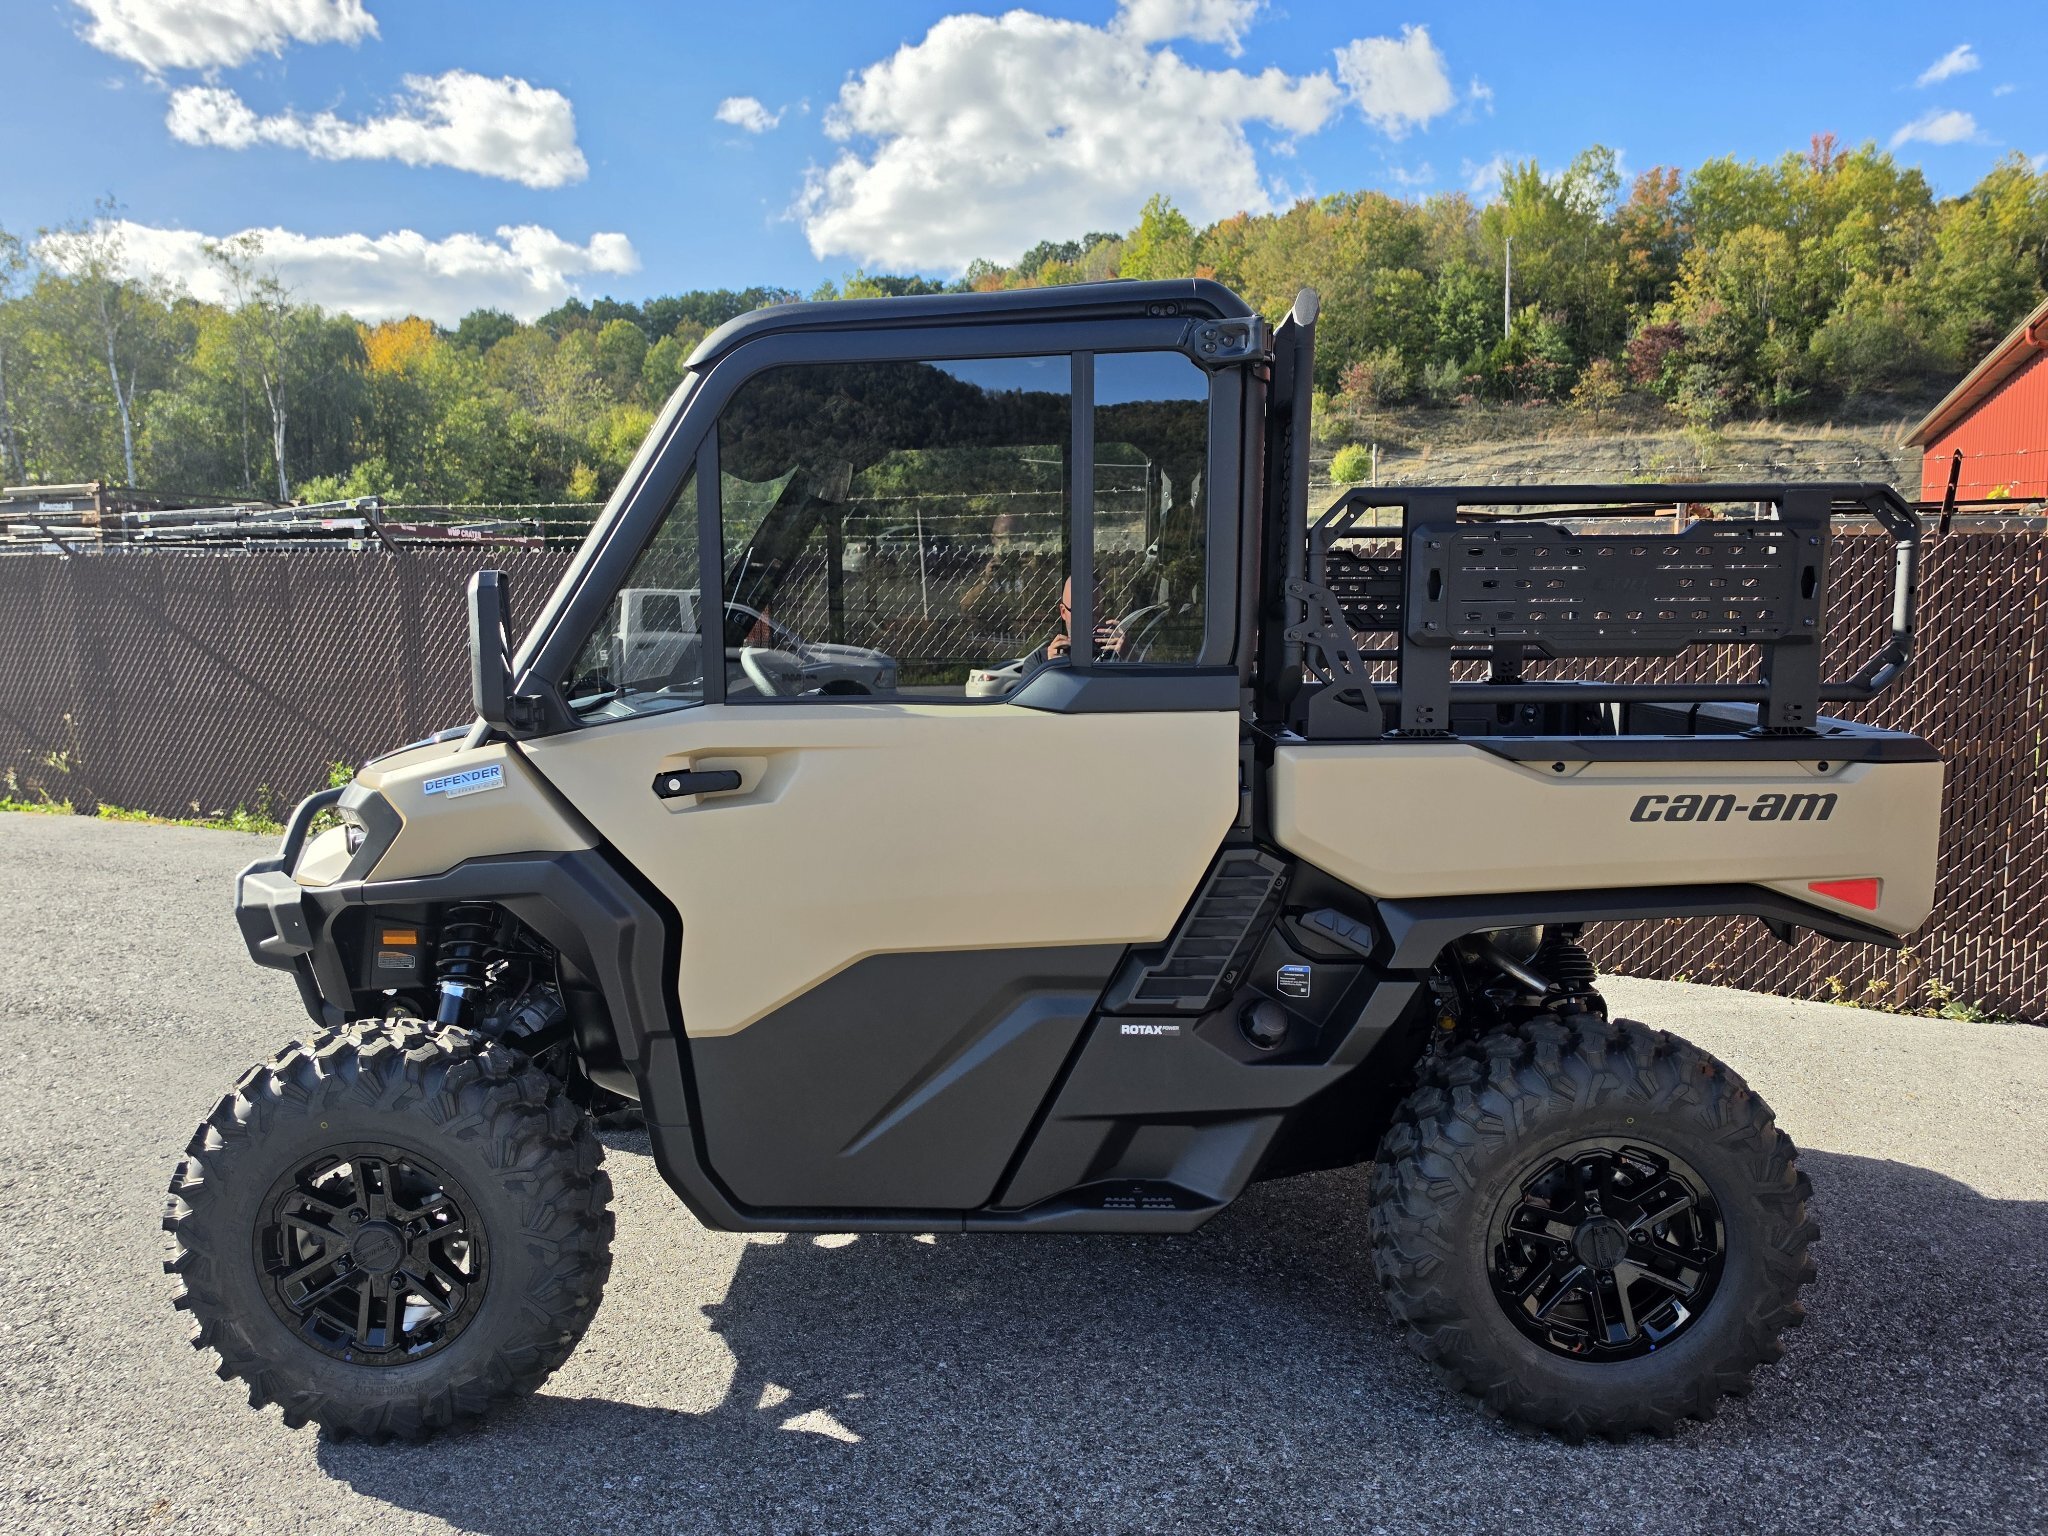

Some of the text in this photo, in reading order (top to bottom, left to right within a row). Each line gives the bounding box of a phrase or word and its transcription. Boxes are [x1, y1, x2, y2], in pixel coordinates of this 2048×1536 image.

[425, 767, 499, 791] DEFENDER
[1630, 793, 1838, 822] can-am
[1121, 1024, 1162, 1035] ROTAX
